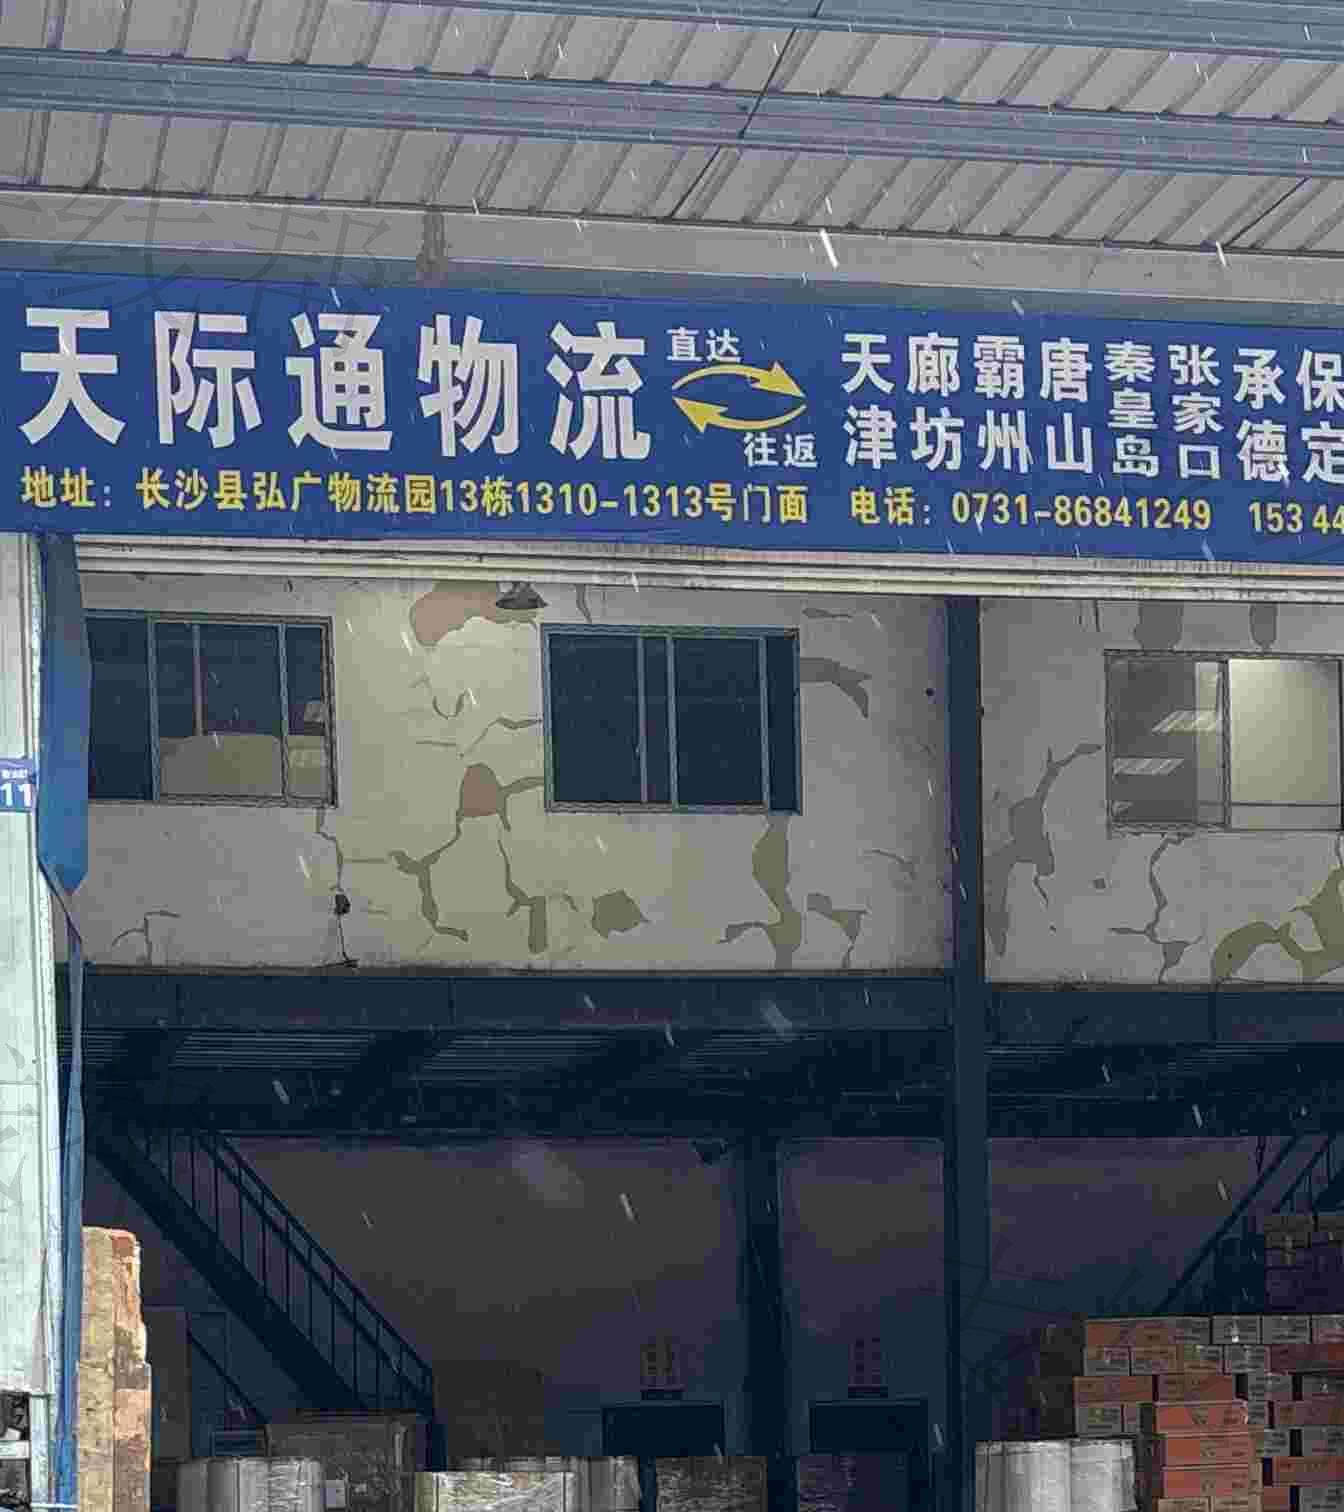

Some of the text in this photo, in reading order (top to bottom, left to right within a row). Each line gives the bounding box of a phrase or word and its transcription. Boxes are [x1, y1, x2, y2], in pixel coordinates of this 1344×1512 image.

[20, 308, 650, 459] 天际通物流
[667, 327, 740, 363] 直达
[842, 334, 896, 469] 天津
[907, 333, 964, 470] 廊坊
[974, 336, 1028, 473] 霸州
[1040, 338, 1092, 473] 唐山
[1104, 341, 1158, 477] 秦皇岛
[1168, 345, 1224, 479] 张家口
[743, 430, 817, 467] 往返
[1233, 349, 1289, 482] 承德
[1249, 503, 1302, 532] 153
